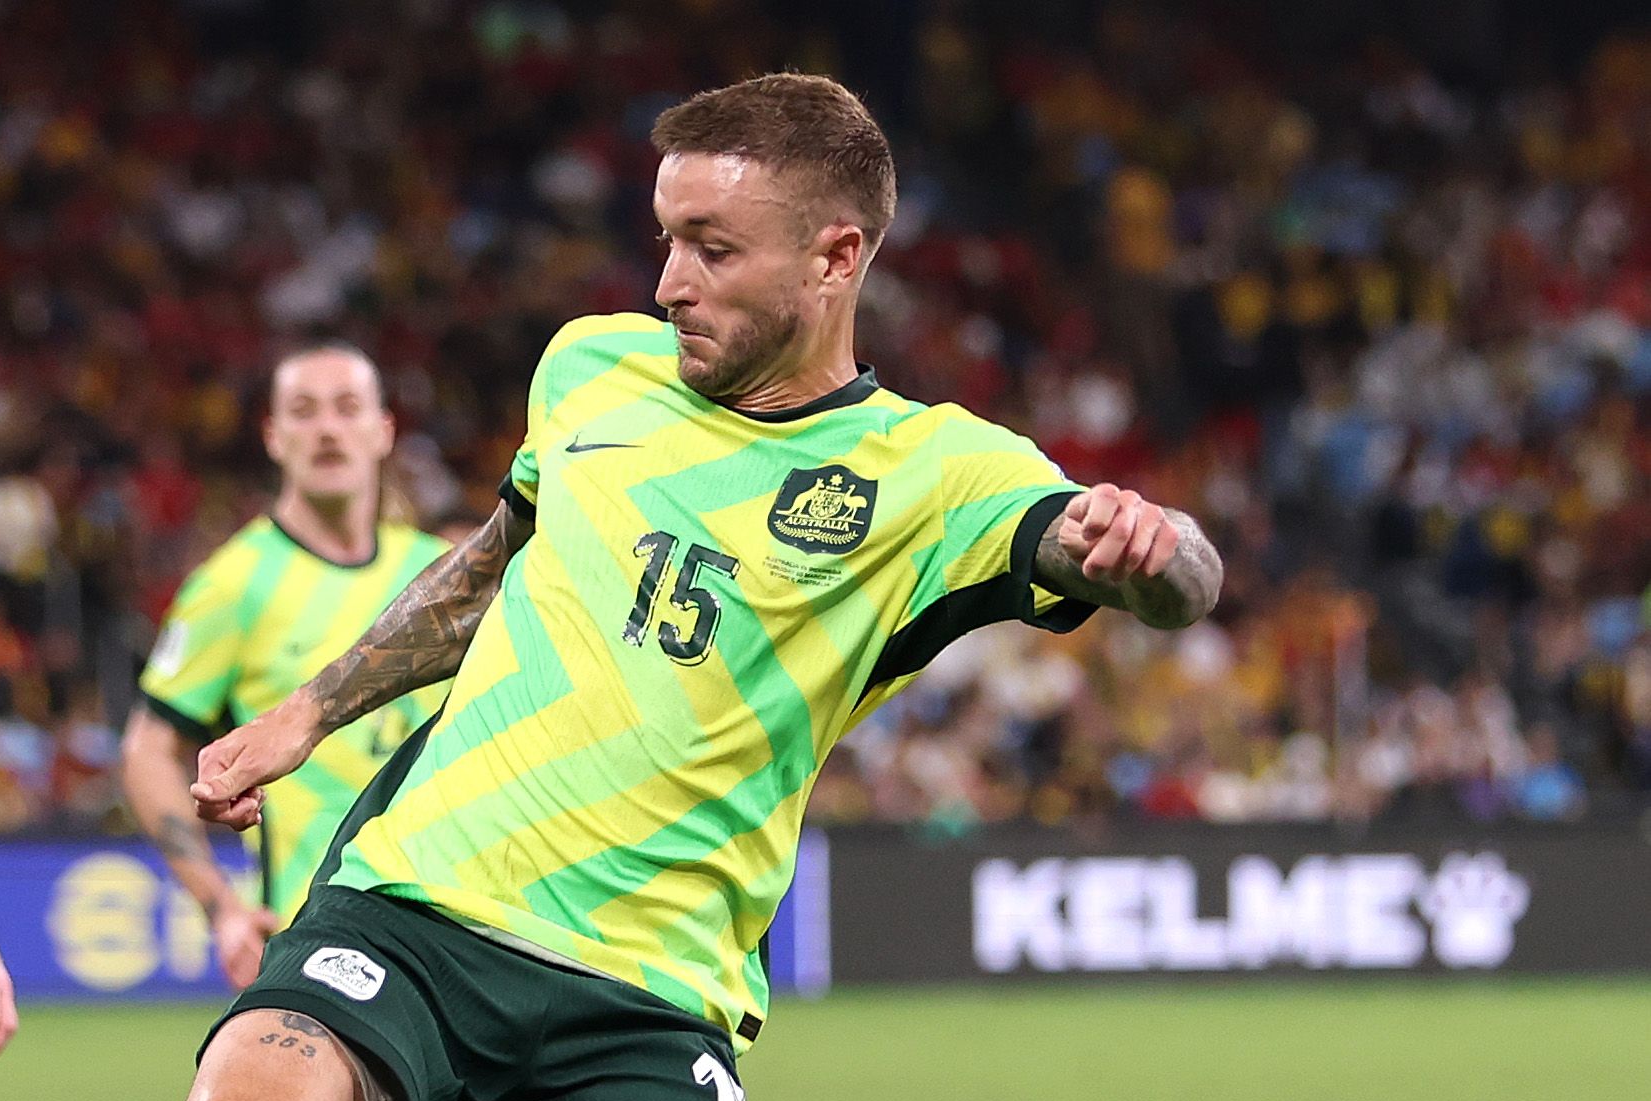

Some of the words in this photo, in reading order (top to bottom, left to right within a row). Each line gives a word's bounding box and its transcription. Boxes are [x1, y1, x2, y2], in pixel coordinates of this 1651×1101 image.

[784, 516, 850, 531] AUSTRALIA
[621, 530, 742, 667] 15
[970, 852, 1428, 973] KELME
